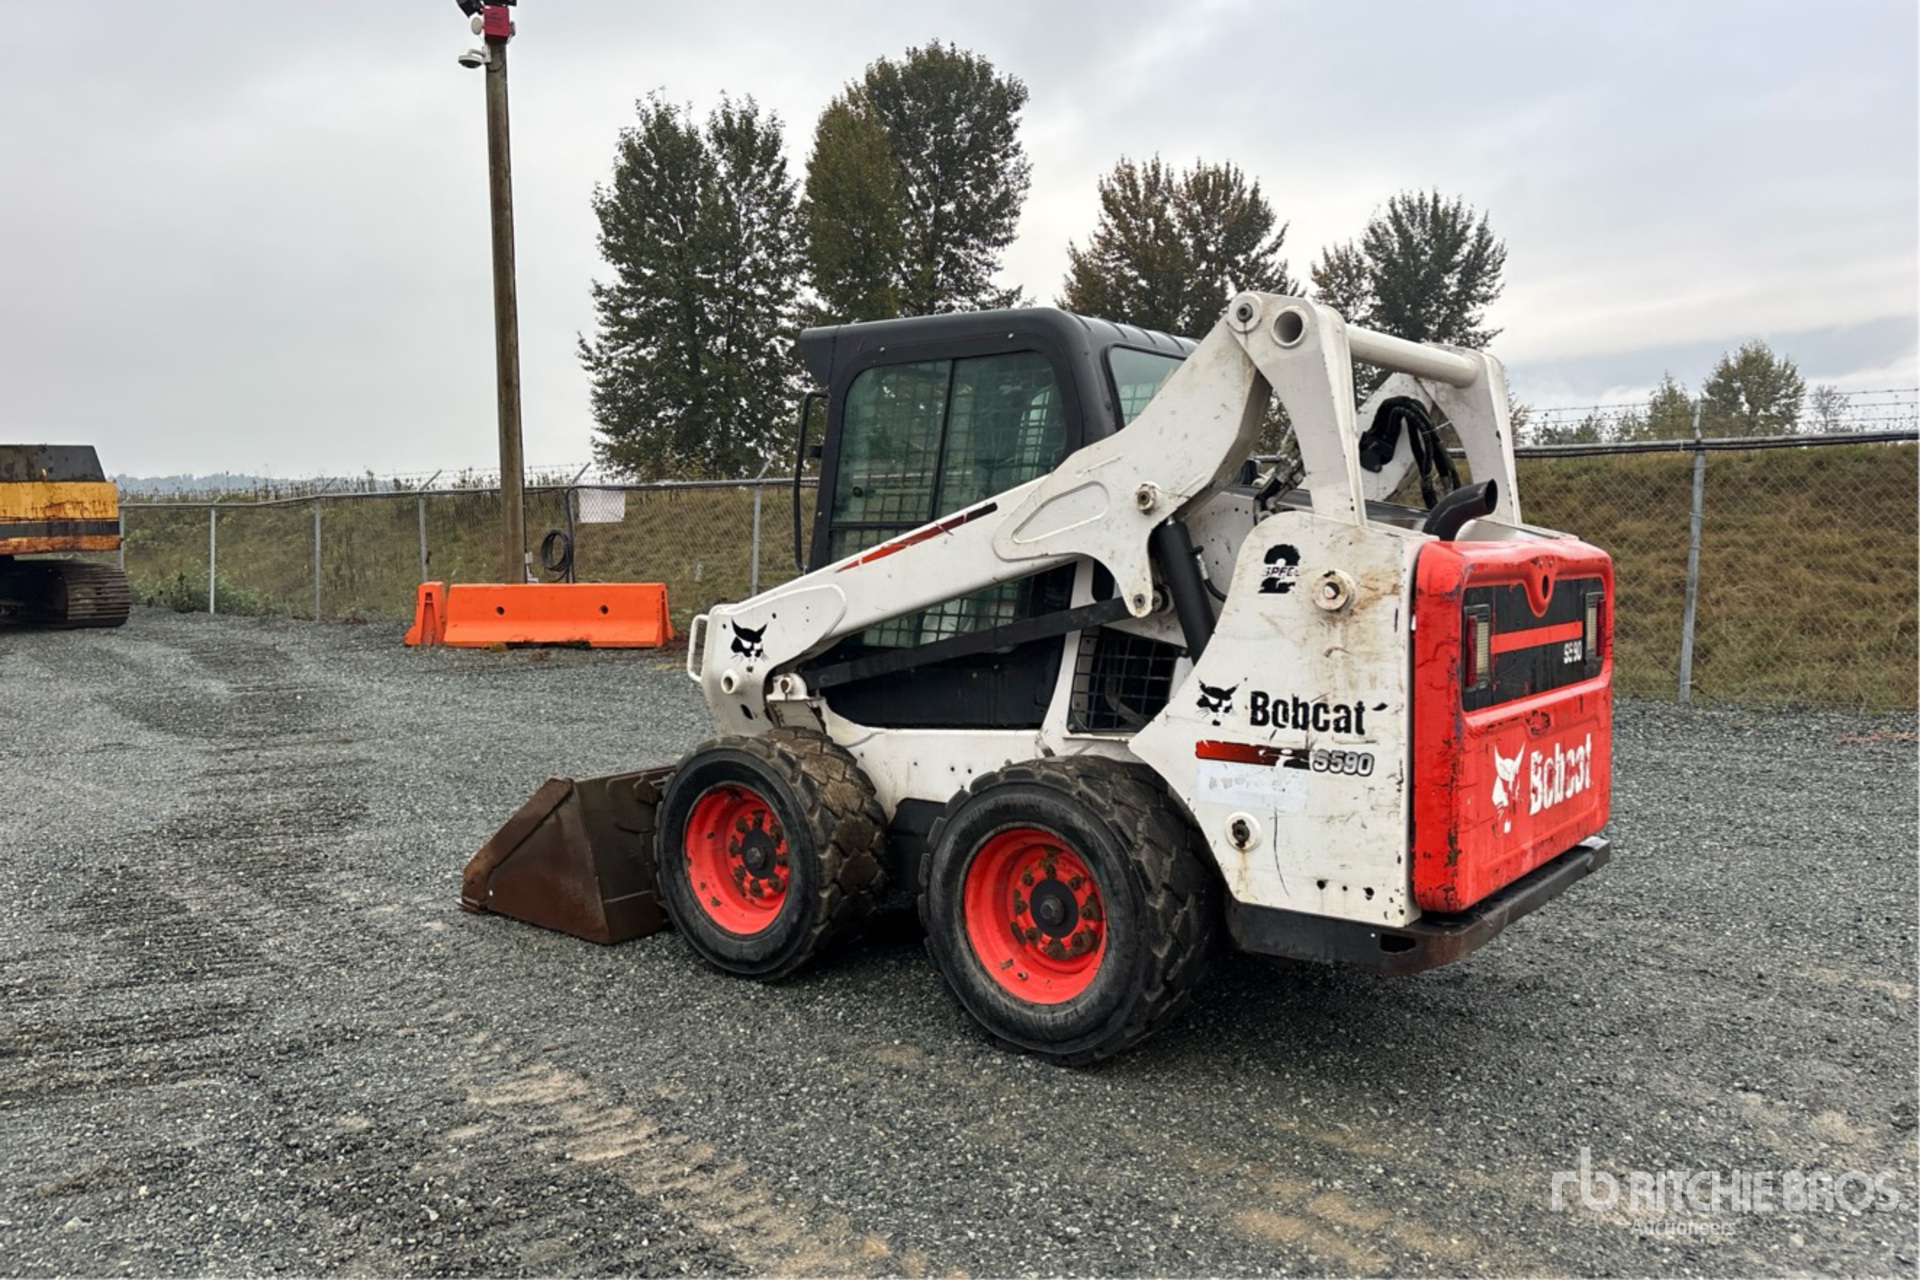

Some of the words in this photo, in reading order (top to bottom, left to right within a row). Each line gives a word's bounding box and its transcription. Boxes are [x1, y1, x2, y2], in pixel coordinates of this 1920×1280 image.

[1250, 690, 1366, 735] Bobcat
[1312, 748, 1375, 777] S590
[1529, 732, 1592, 816] Bobcat
